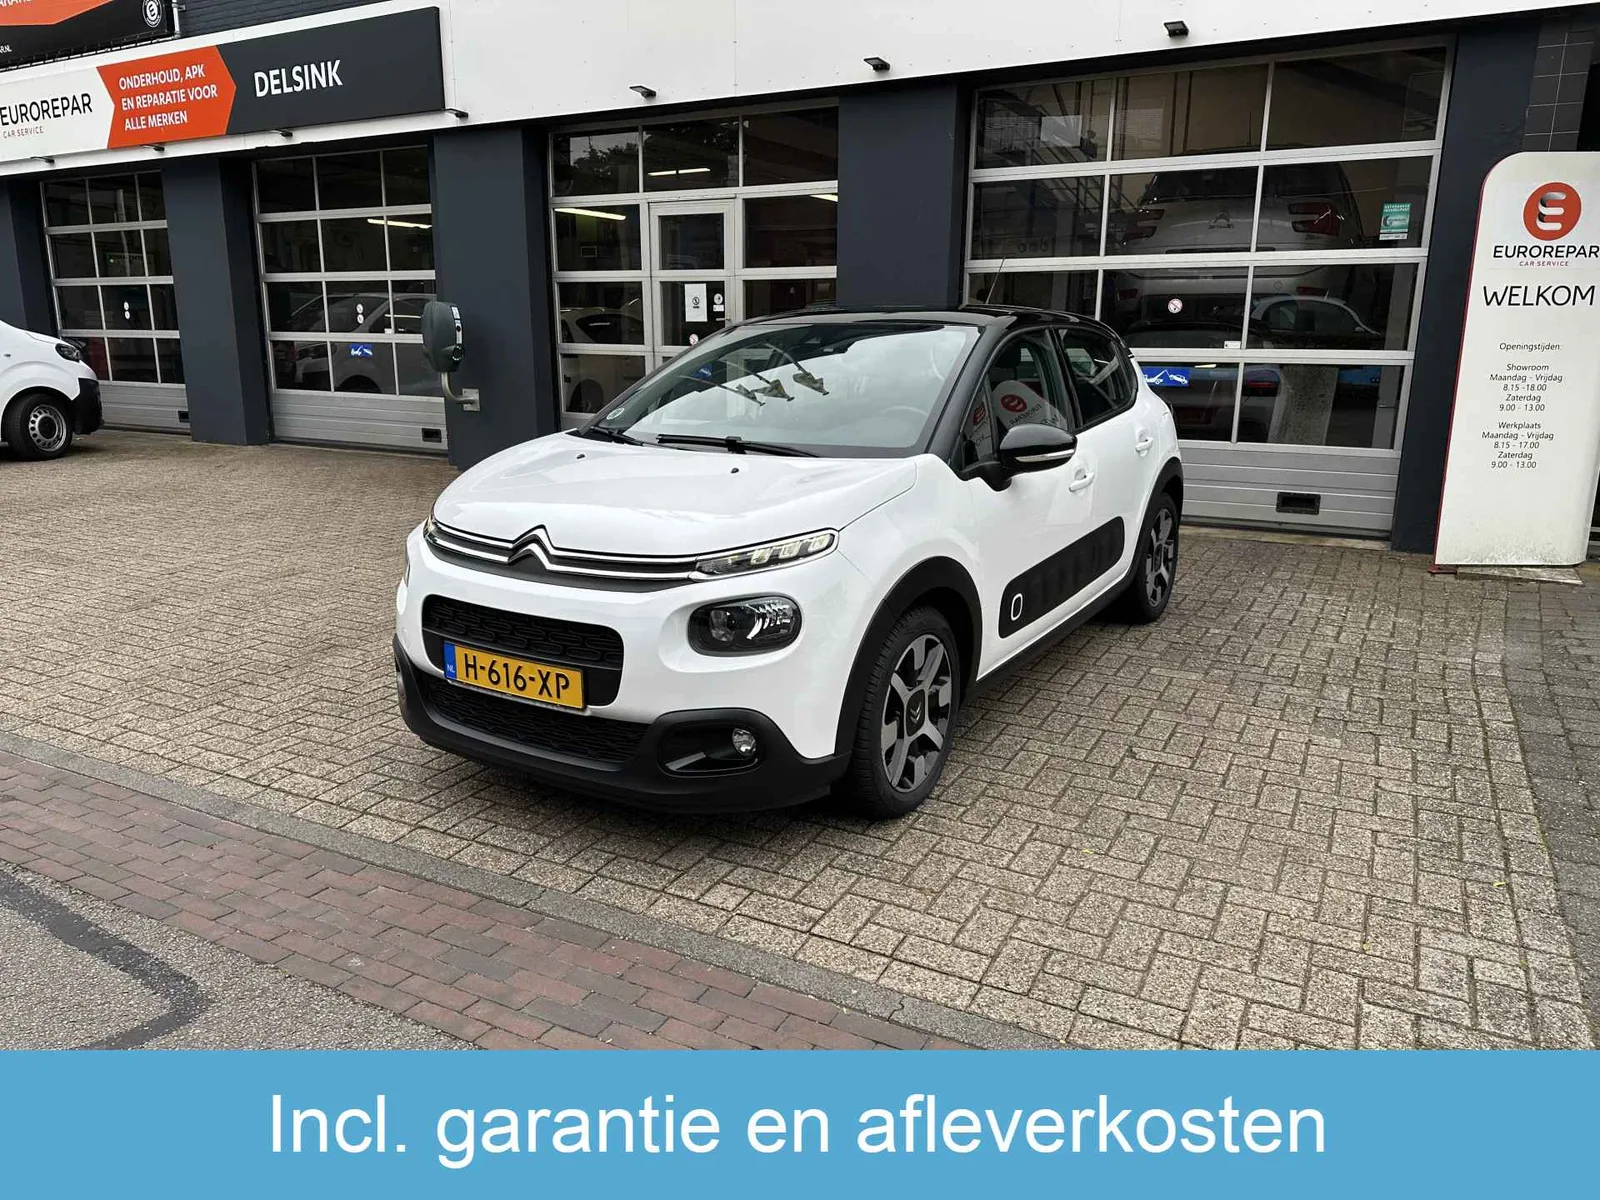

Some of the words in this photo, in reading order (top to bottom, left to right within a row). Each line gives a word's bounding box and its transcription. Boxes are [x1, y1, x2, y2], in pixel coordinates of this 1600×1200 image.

[119, 68, 183, 90] ONDERHOUD,
[185, 64, 206, 79] APK
[253, 59, 343, 97] DELSINK
[121, 97, 135, 111] EN
[136, 89, 187, 109] REPARATIE
[188, 84, 218, 101] VOOR
[0, 92, 93, 126] EUROREPAR
[124, 118, 147, 131] ALLE
[148, 110, 188, 128] MERKEN
[3, 129, 16, 139] CAR
[17, 125, 44, 138] SERVICE
[1493, 245, 1600, 259] EUROREPAR
[1482, 285, 1596, 307] WELKOM
[1506, 363, 1549, 371] Showroom
[1489, 373, 1527, 382] Maandag
[1535, 373, 1563, 383] Vrijdag
[1505, 394, 1542, 403] Zaterdag
[1498, 422, 1541, 430] Werkplaats
[1481, 431, 1519, 440] Maandag
[1527, 431, 1554, 440] Vrijdag
[1494, 441, 1511, 449] 8.15
[1519, 441, 1540, 449] 17.00
[1498, 451, 1533, 460] Zaterdag
[464, 653, 570, 699] H-616-XP
